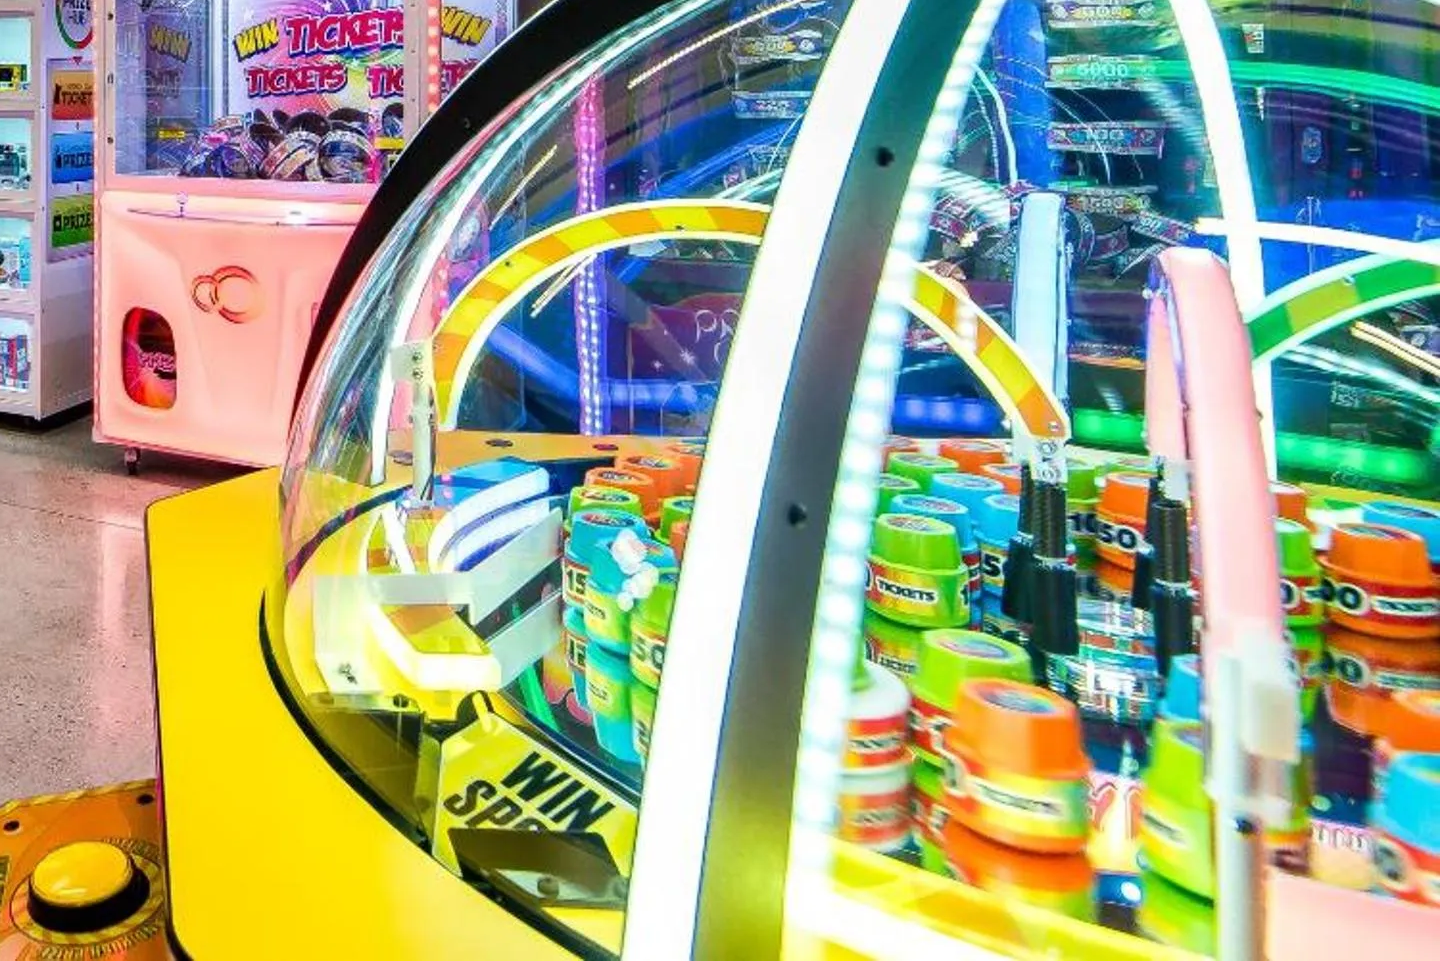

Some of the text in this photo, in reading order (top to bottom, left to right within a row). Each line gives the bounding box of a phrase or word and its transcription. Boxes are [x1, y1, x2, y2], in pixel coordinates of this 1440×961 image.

[233, 17, 280, 61] WIN
[246, 62, 348, 98] TICKETS
[877, 577, 936, 602] TICKETS
[501, 751, 616, 833] WIN
